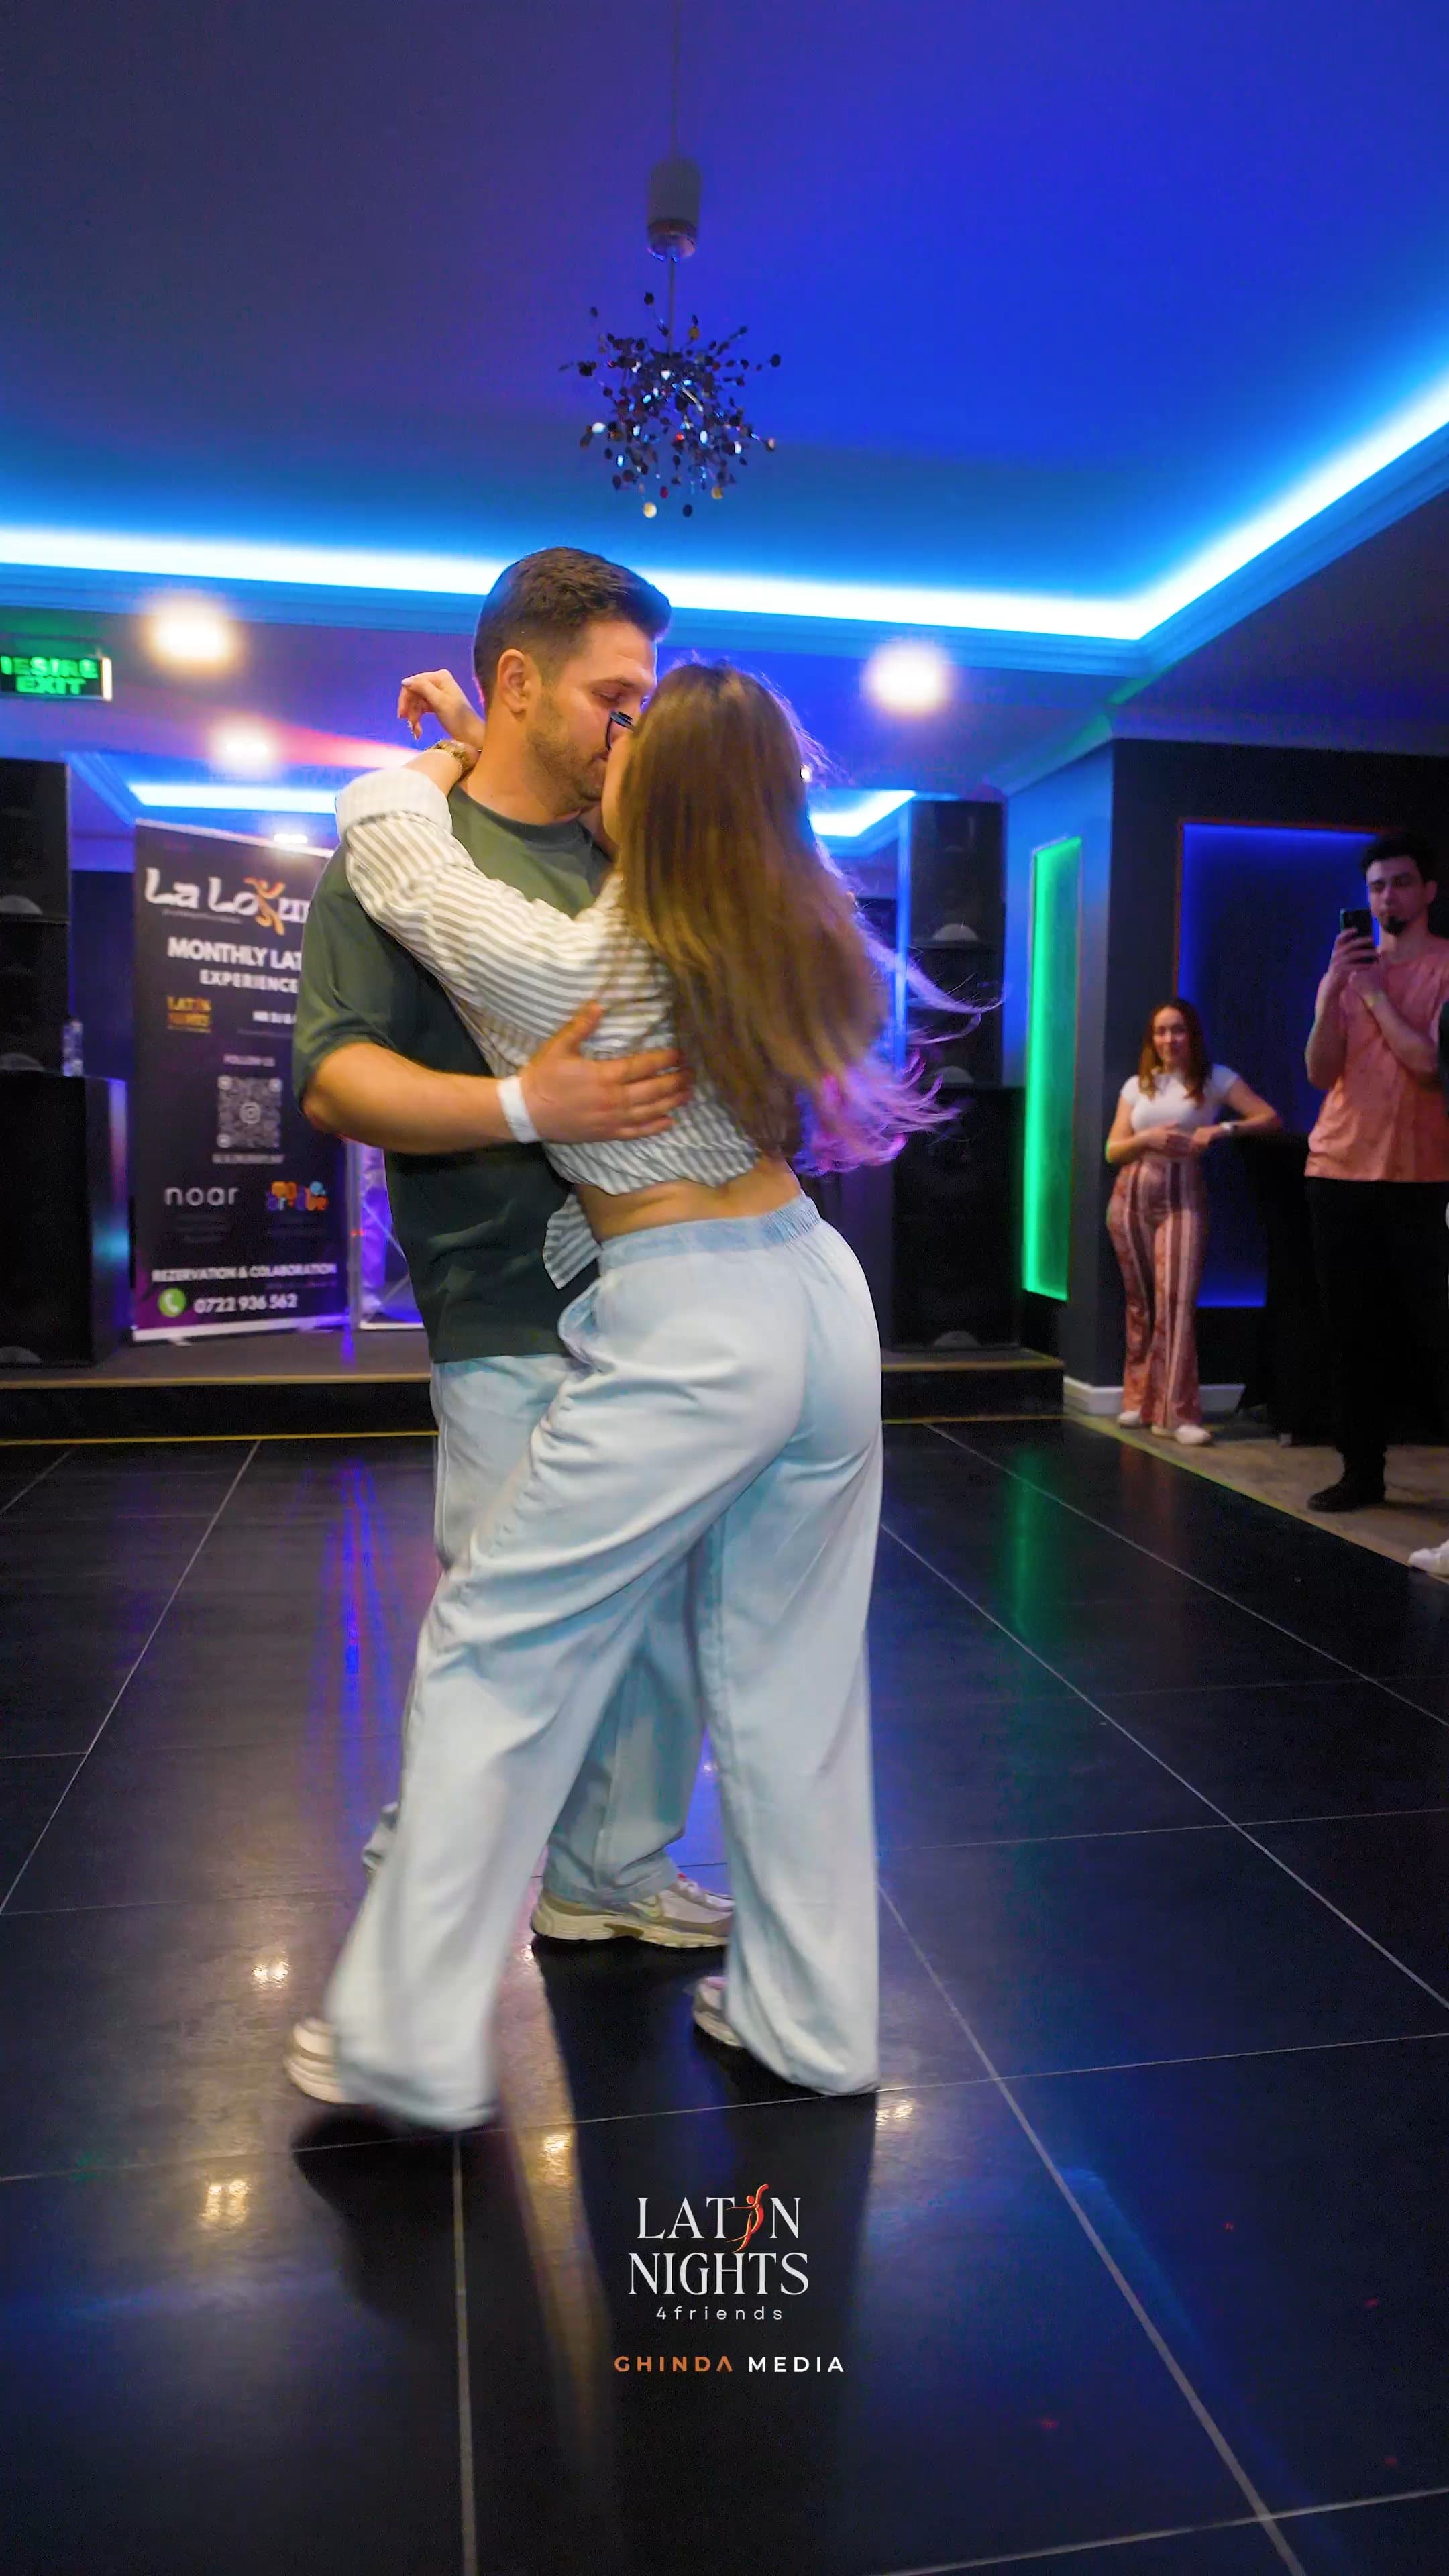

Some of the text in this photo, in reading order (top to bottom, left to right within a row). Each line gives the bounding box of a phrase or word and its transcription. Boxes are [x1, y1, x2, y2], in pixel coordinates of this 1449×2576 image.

[16, 675, 86, 695] EXIT
[144, 867, 200, 909] La
[167, 936, 302, 971] MONTHLY LAT
[199, 969, 299, 994] EXPERIENCE
